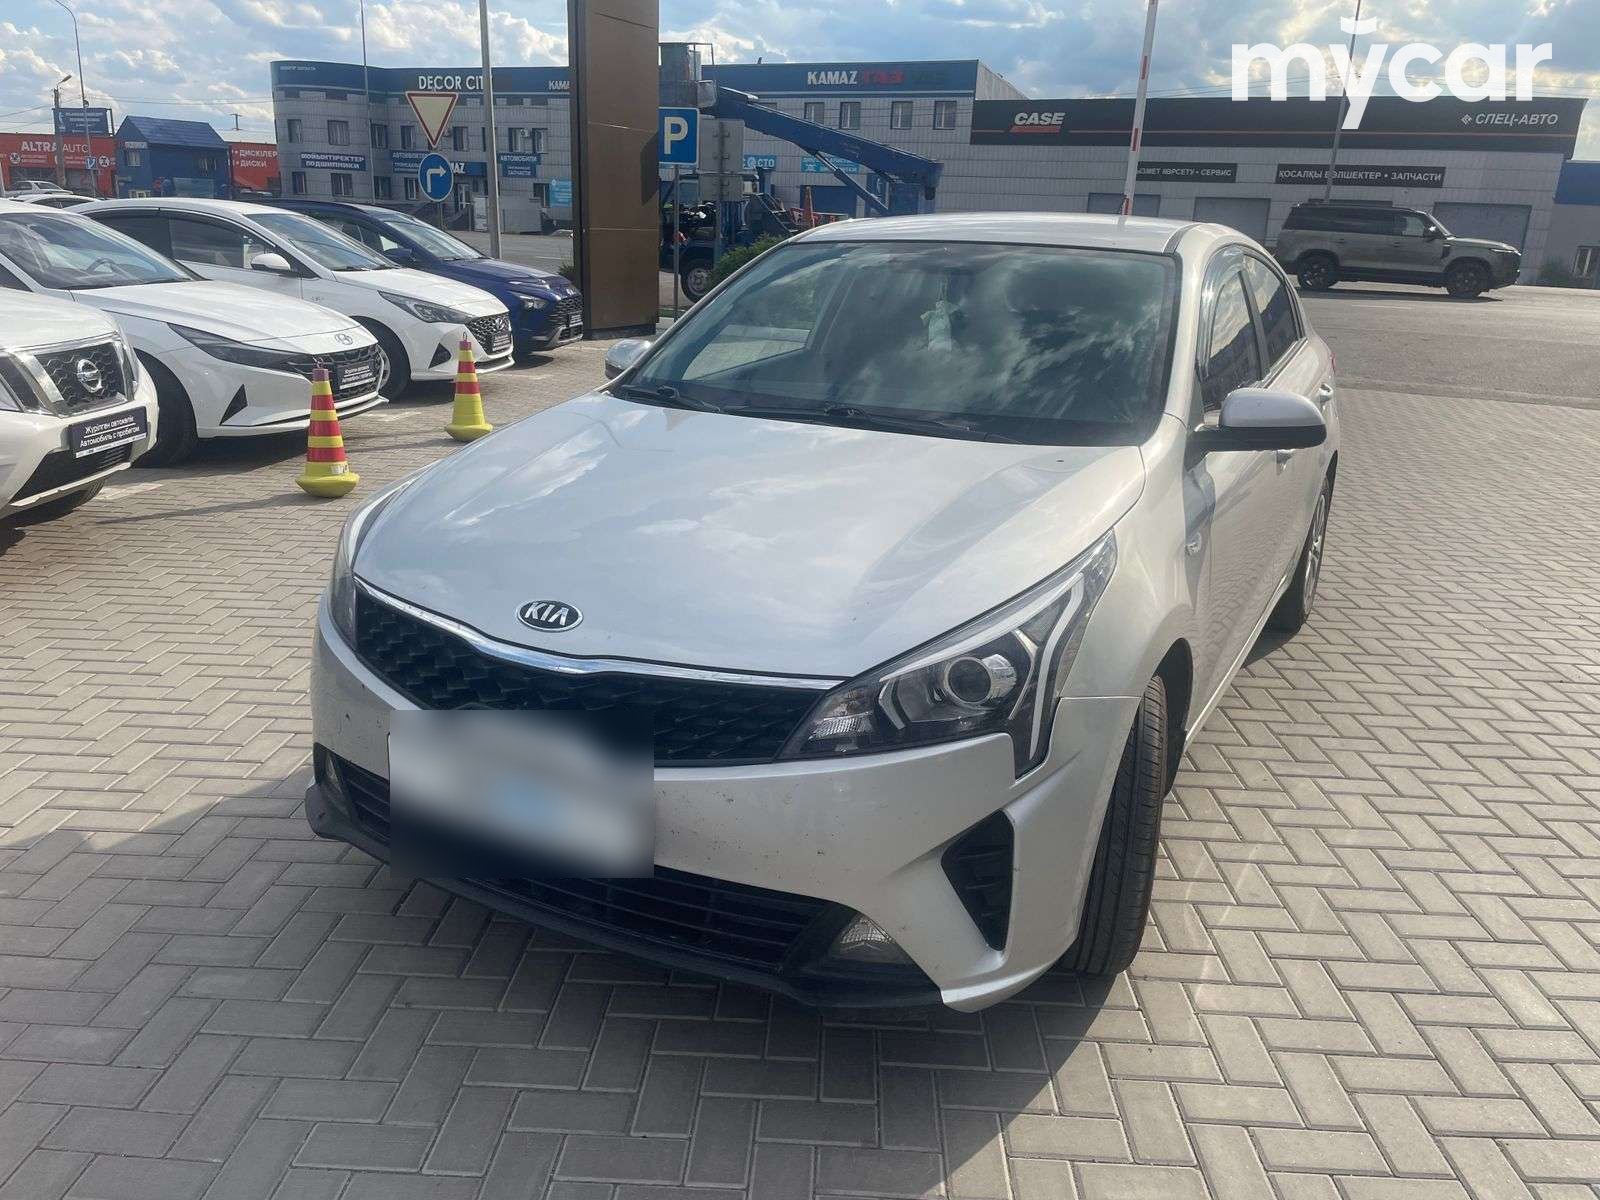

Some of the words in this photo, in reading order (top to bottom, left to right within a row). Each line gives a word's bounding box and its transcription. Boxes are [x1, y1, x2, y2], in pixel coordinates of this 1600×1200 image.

[418, 75, 461, 90] DECOR
[465, 75, 493, 90] CIT
[807, 70, 858, 85] KAMAZ
[1014, 112, 1066, 125] CASE
[1475, 113, 1559, 127] СПЕЦ-АВТО
[664, 116, 689, 155] P
[63, 143, 89, 153] AUTO
[240, 159, 267, 168] ДИСКИ
[1200, 169, 1232, 177] СЕРВИС
[1390, 172, 1441, 182] ЗАПЧАСТИ
[524, 602, 569, 626] KIA
